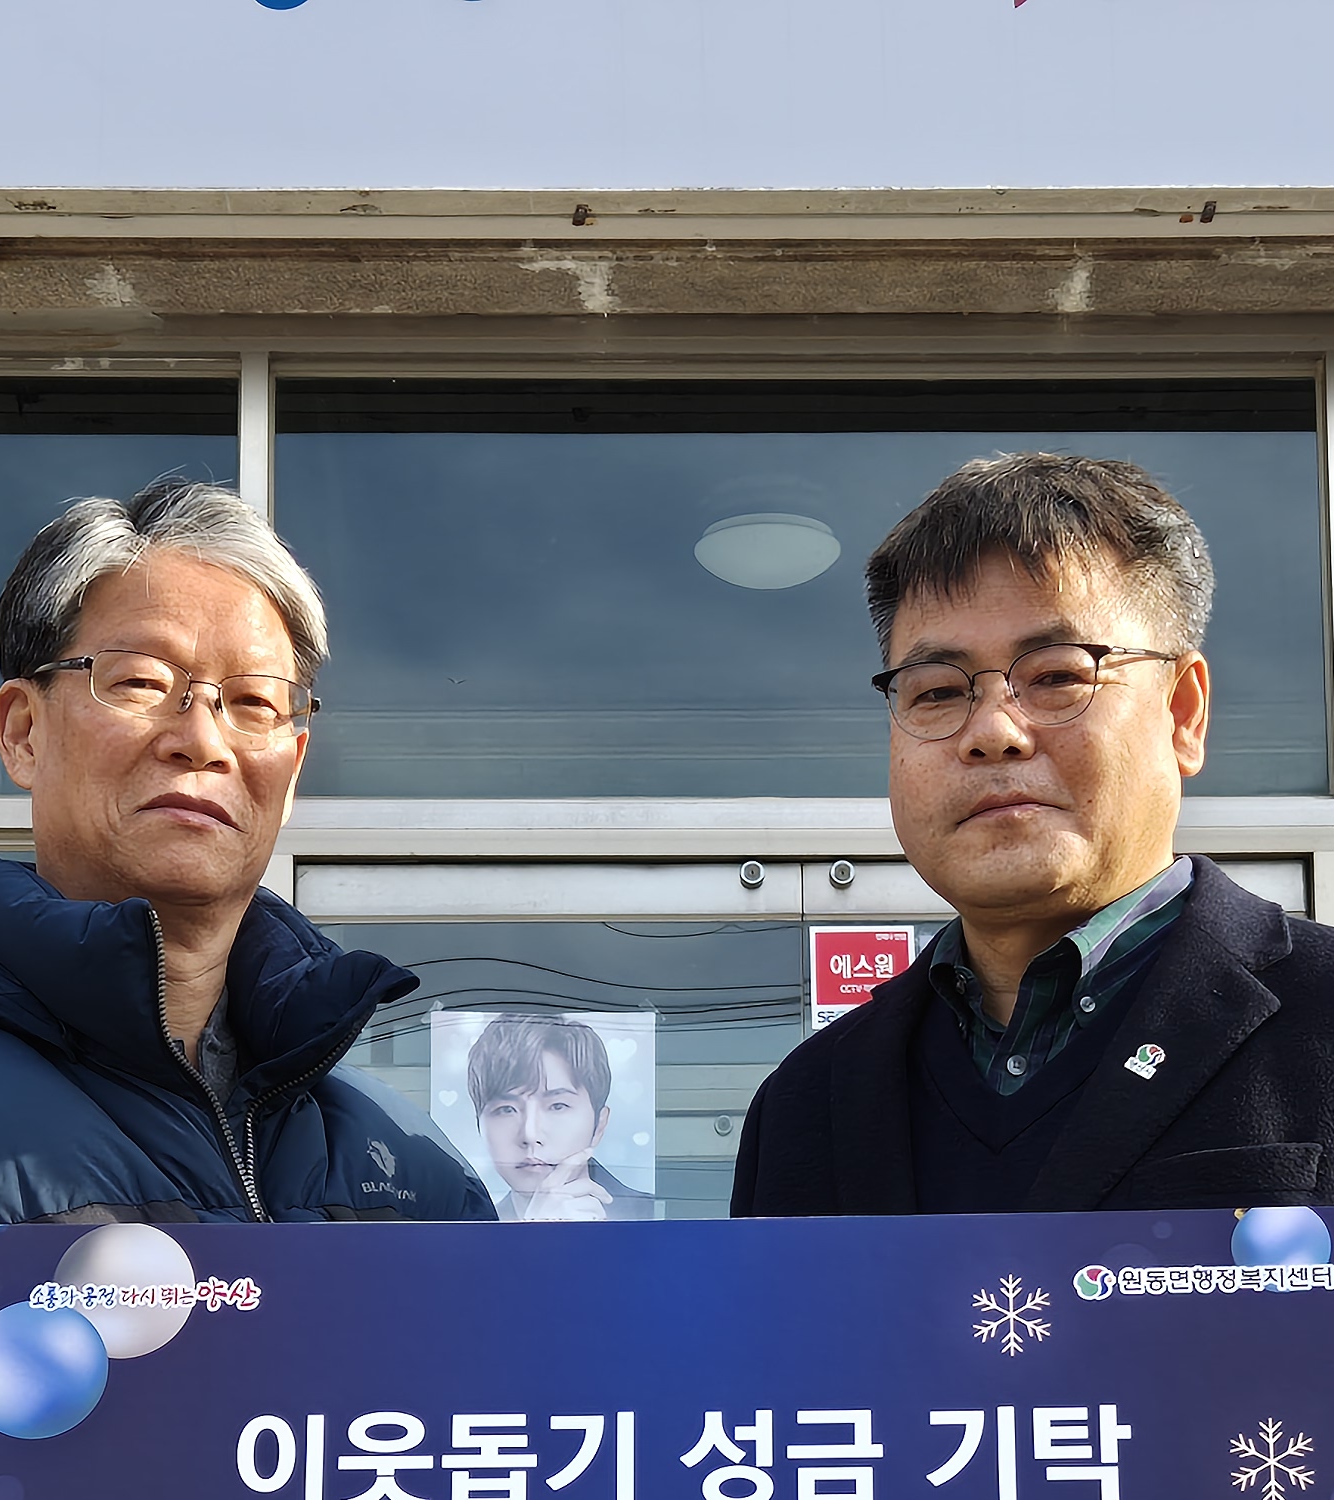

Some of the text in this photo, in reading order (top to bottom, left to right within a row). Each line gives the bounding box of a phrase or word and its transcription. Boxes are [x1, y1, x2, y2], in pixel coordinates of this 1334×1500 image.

[830, 954, 894, 978] 에스원
[1121, 1266, 1333, 1291] 원동면행정복지센터
[83, 1286, 115, 1307] 공정
[122, 1287, 156, 1306] 다시
[161, 1287, 194, 1306] 뛰는
[198, 1279, 259, 1308] 양산
